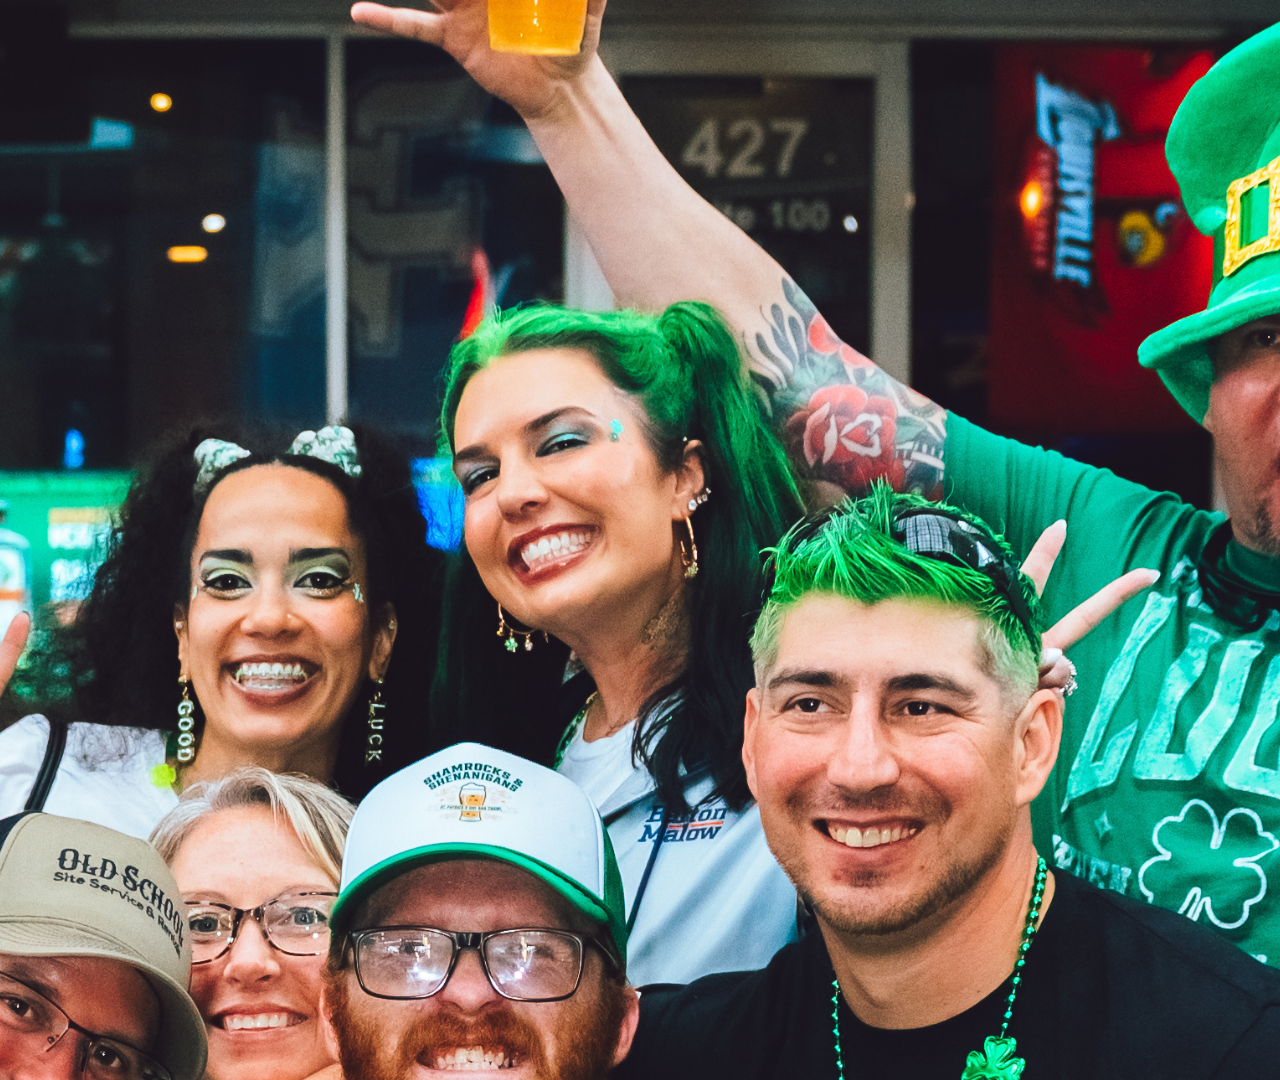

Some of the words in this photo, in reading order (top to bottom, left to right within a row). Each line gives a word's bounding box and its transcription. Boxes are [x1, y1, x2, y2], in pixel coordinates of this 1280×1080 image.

[681, 118, 807, 177] 427
[177, 700, 195, 763] GOOD
[423, 763, 511, 785] SHAMROCKS
[513, 778, 523, 787] &
[428, 772, 518, 792] SHENANIGANS
[53, 872, 86, 885] Site
[89, 878, 145, 911] Service
[146, 906, 155, 919] &
[58, 848, 119, 881] OLD
[121, 865, 184, 948] SCHOOL
